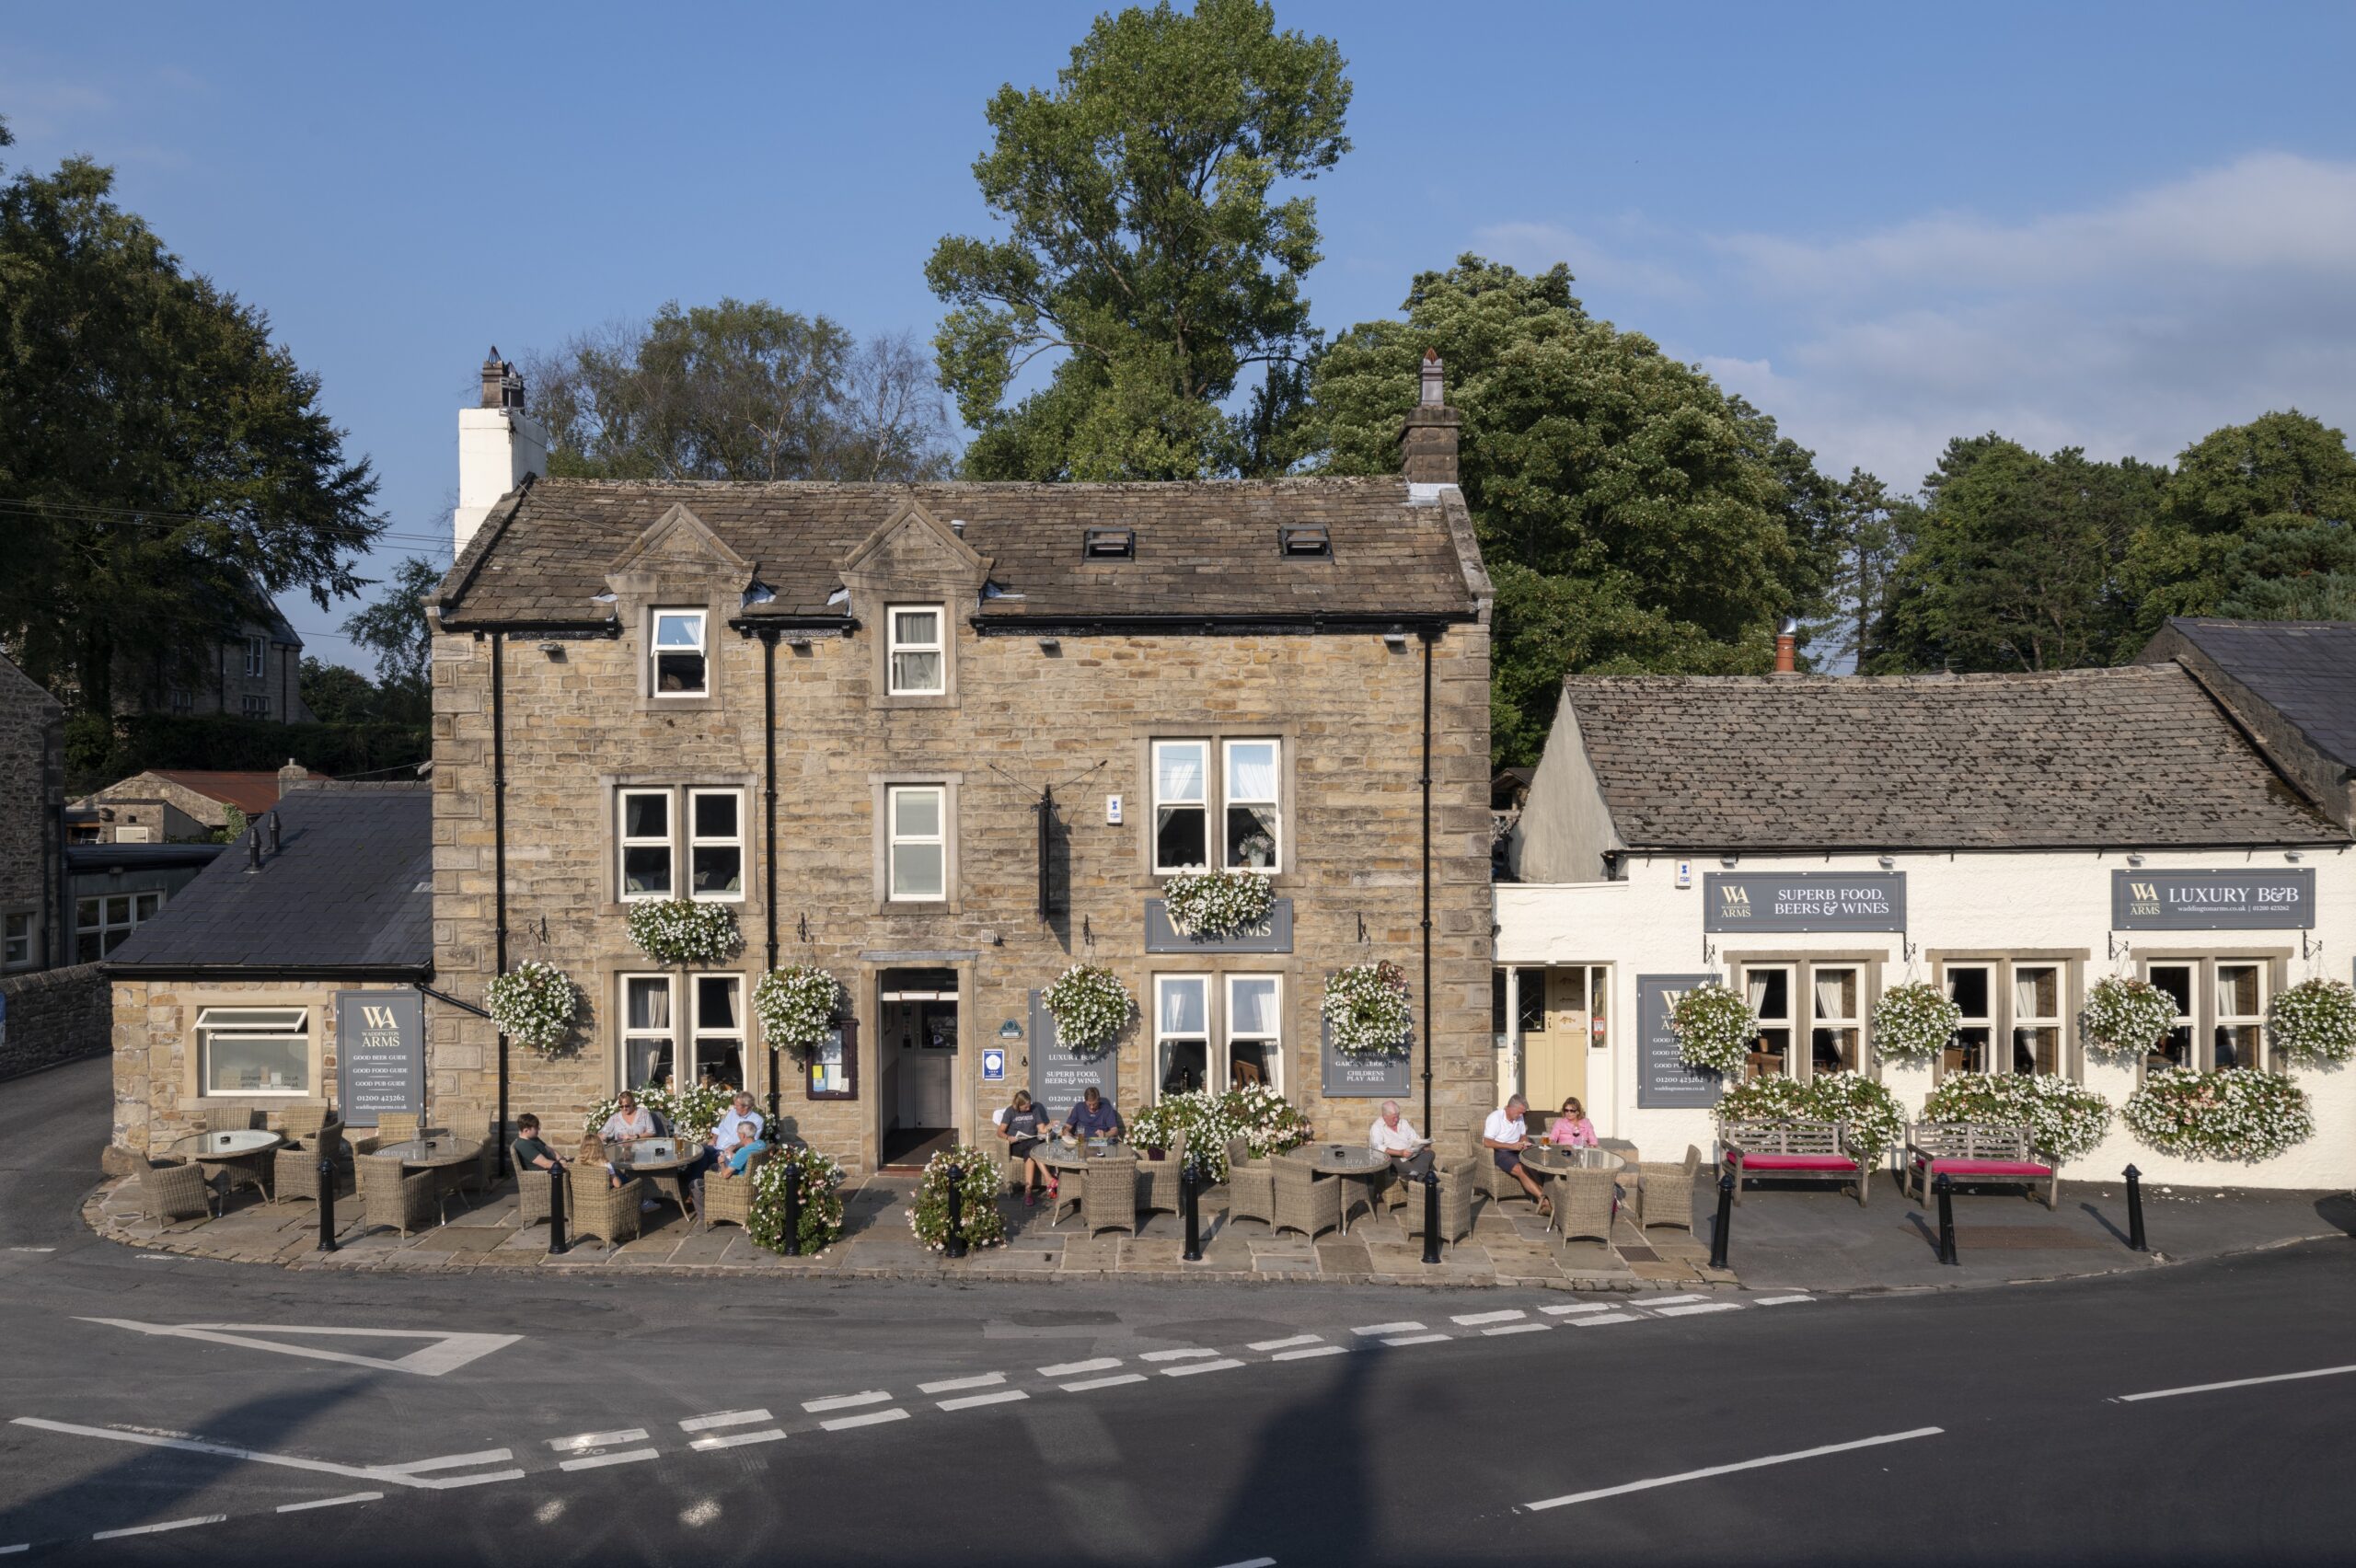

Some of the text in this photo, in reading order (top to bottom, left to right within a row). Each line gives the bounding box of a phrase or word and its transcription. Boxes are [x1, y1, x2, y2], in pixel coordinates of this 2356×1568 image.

[1720, 885, 1750, 904] WA
[1778, 889, 1836, 901] SUPERB
[2129, 882, 2160, 901] WA
[2169, 887, 2299, 903] LUXURY B&B
[1721, 908, 1751, 918] ARMS
[1774, 901, 1889, 916] BEERS & WINES
[2130, 906, 2160, 916] ARMS
[360, 1006, 400, 1029] WA
[361, 1036, 400, 1047] ARMS
[380, 1094, 406, 1102] 423262
